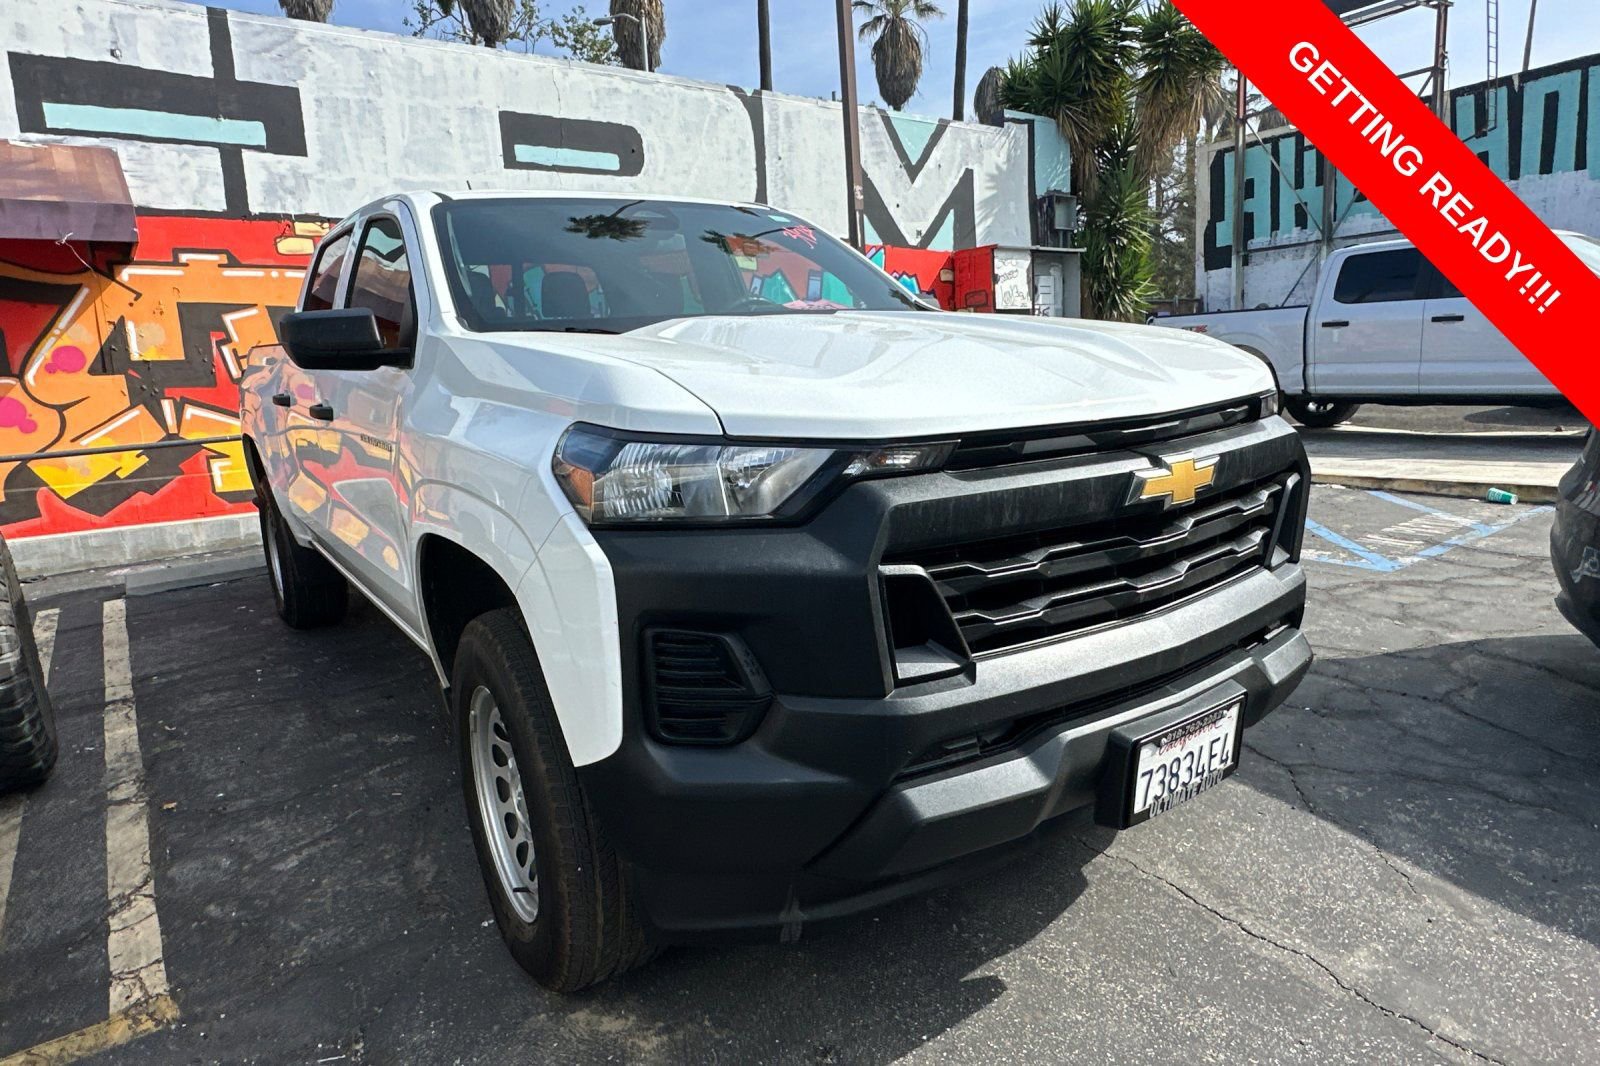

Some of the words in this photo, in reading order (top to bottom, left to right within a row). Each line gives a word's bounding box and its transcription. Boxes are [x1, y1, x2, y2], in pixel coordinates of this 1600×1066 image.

[1140, 732, 1230, 809] 73834E4
[1149, 781, 1200, 819] ULTIMATE
[1199, 767, 1224, 793] AUTO
